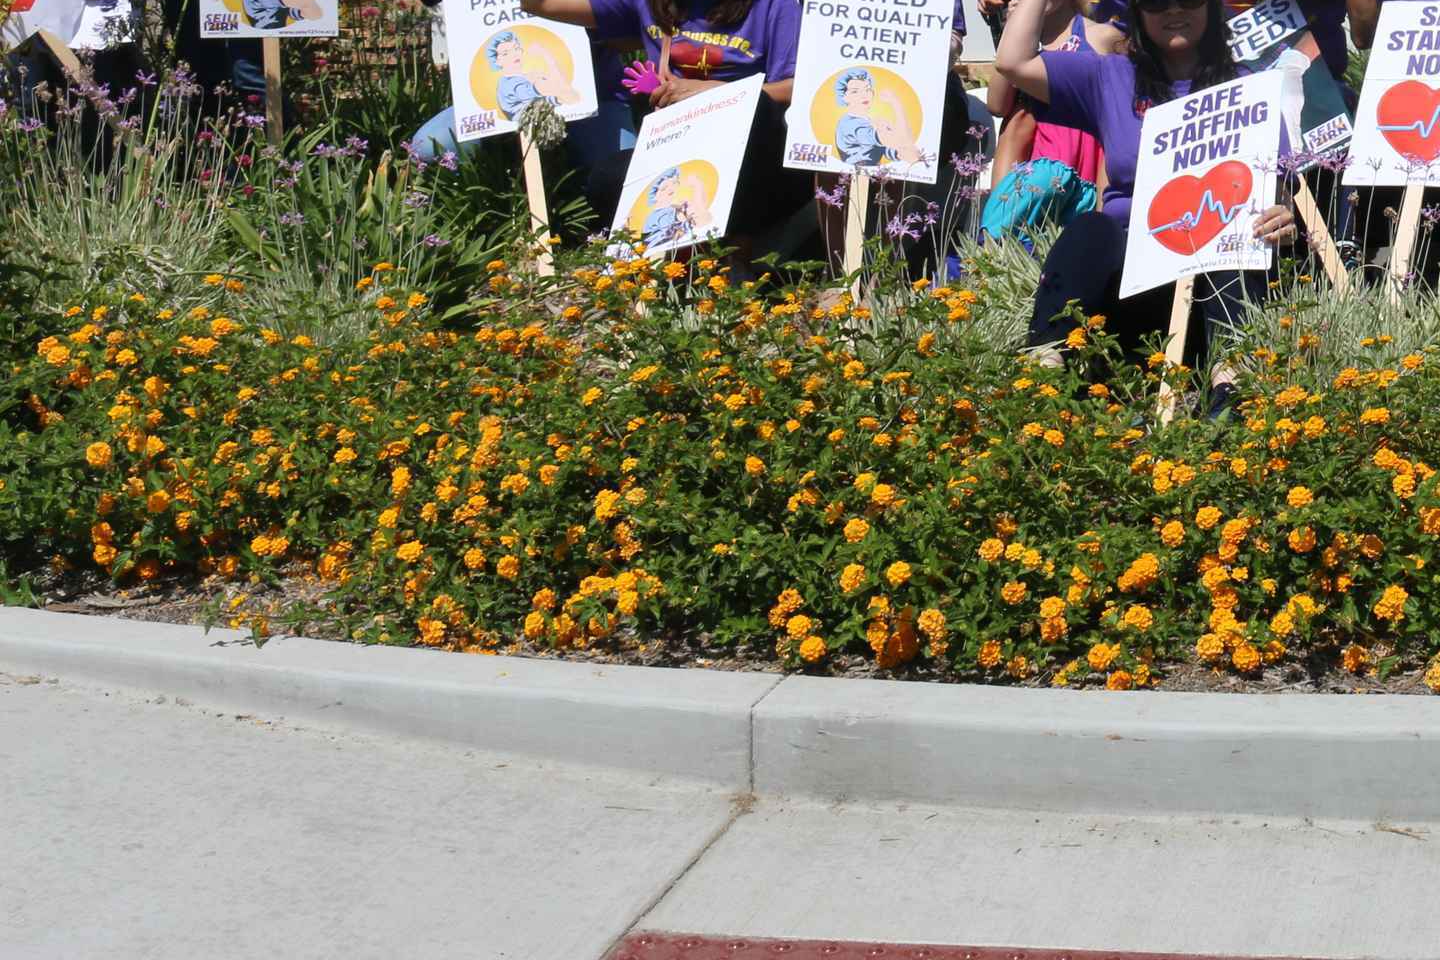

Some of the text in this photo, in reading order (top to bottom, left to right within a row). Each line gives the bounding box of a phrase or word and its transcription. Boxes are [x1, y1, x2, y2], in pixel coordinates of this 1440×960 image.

[806, 1, 950, 30] FOR QUALITY
[830, 23, 921, 45] PATIENT
[840, 44, 906, 65] CARE!
[649, 91, 748, 137] humankindness?
[1182, 83, 1243, 122] SAFE
[645, 125, 692, 151] Where?
[1152, 101, 1268, 155] STAFFING
[1172, 133, 1241, 173] NOW!
